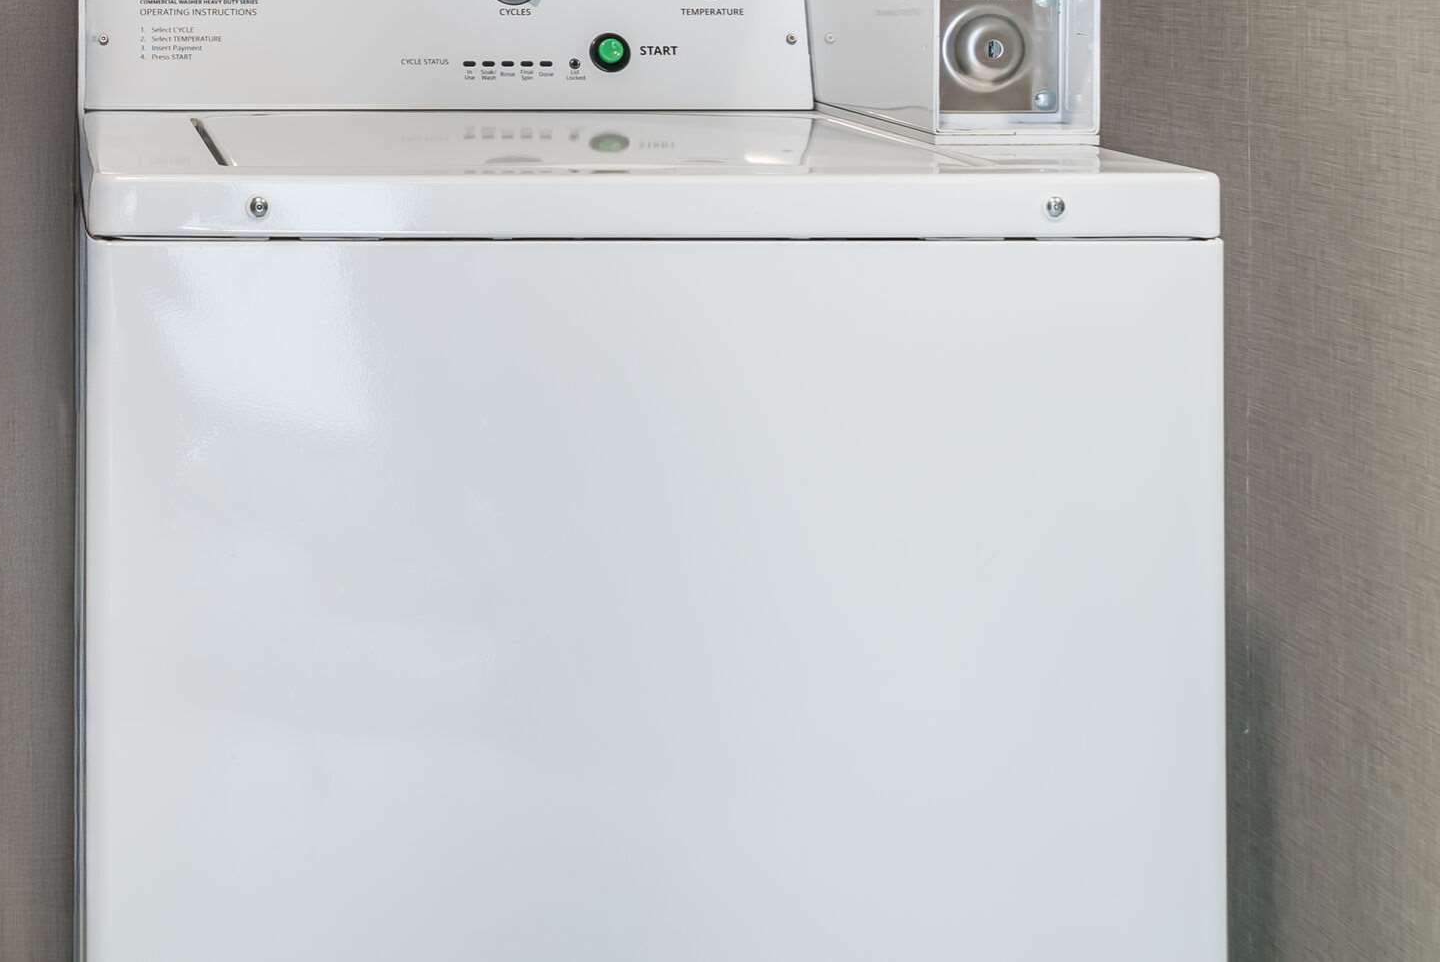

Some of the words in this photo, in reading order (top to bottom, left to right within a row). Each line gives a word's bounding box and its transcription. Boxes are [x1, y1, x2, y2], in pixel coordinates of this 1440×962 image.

[139, 8, 190, 17] OPERATING
[192, 8, 258, 17] INSTRUCTIONS
[499, 8, 532, 16] CYCLES
[680, 8, 745, 16] TEMPERATURE
[173, 35, 223, 43] TEMPERATURE
[151, 44, 172, 52] Insert
[172, 44, 203, 52] Payment
[639, 45, 678, 56] START
